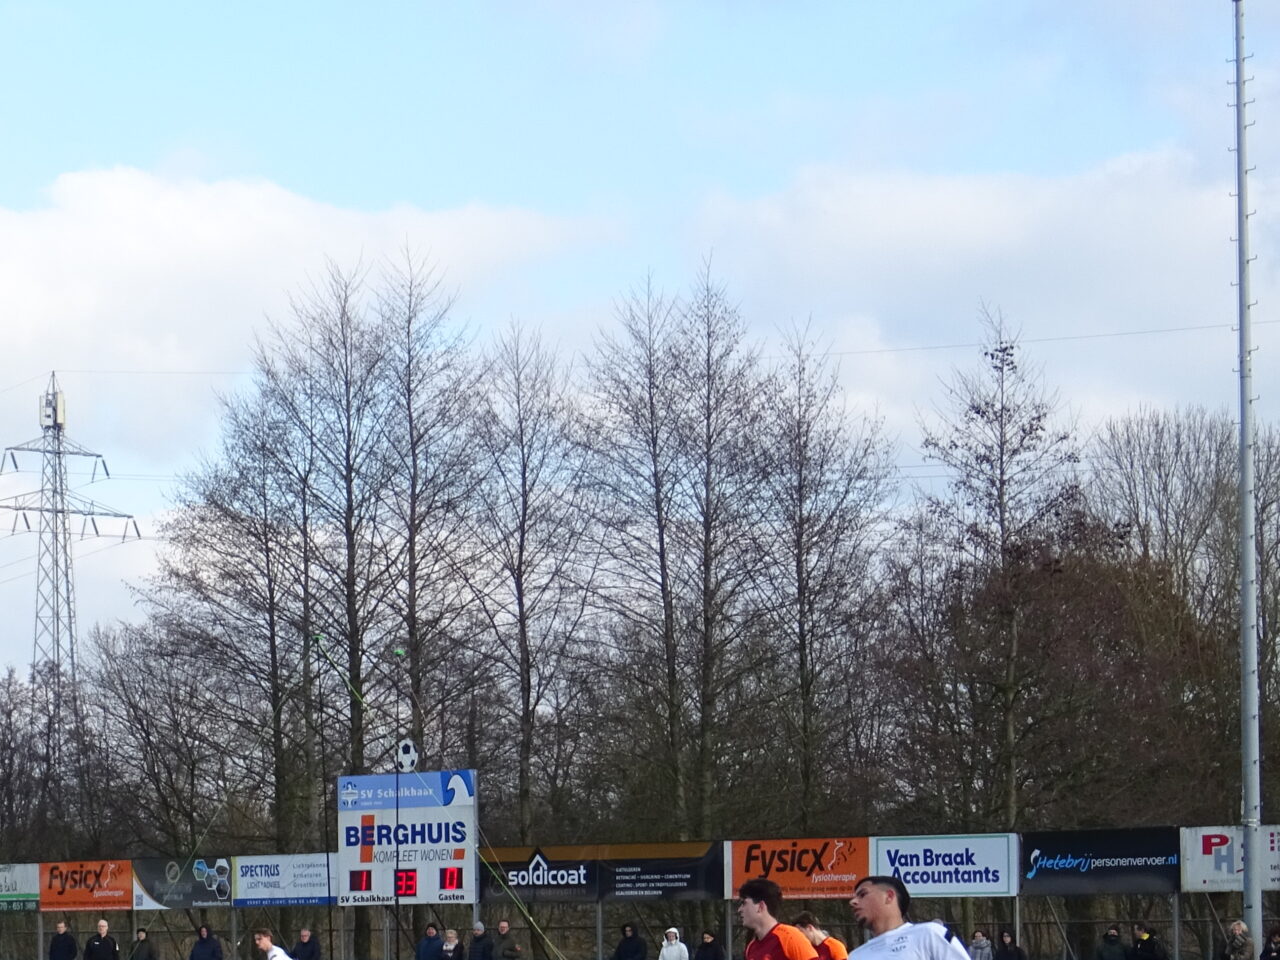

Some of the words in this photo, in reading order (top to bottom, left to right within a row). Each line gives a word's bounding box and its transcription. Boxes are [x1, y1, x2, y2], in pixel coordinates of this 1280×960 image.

[360, 789, 373, 799] SV
[345, 821, 466, 847] BERGHUIS
[420, 848, 453, 861] WONEN
[886, 849, 920, 868] Van
[923, 848, 976, 867] Braak
[361, 871, 367, 891] 1
[445, 867, 458, 890] 0
[508, 860, 587, 886] soldicoat
[812, 872, 857, 883] fysiotherapie
[892, 866, 1000, 885] Accountants
[396, 872, 417, 895] 33
[340, 895, 350, 904] SV
[352, 894, 394, 904] Schalkhaar
[438, 893, 465, 902] Gasten
